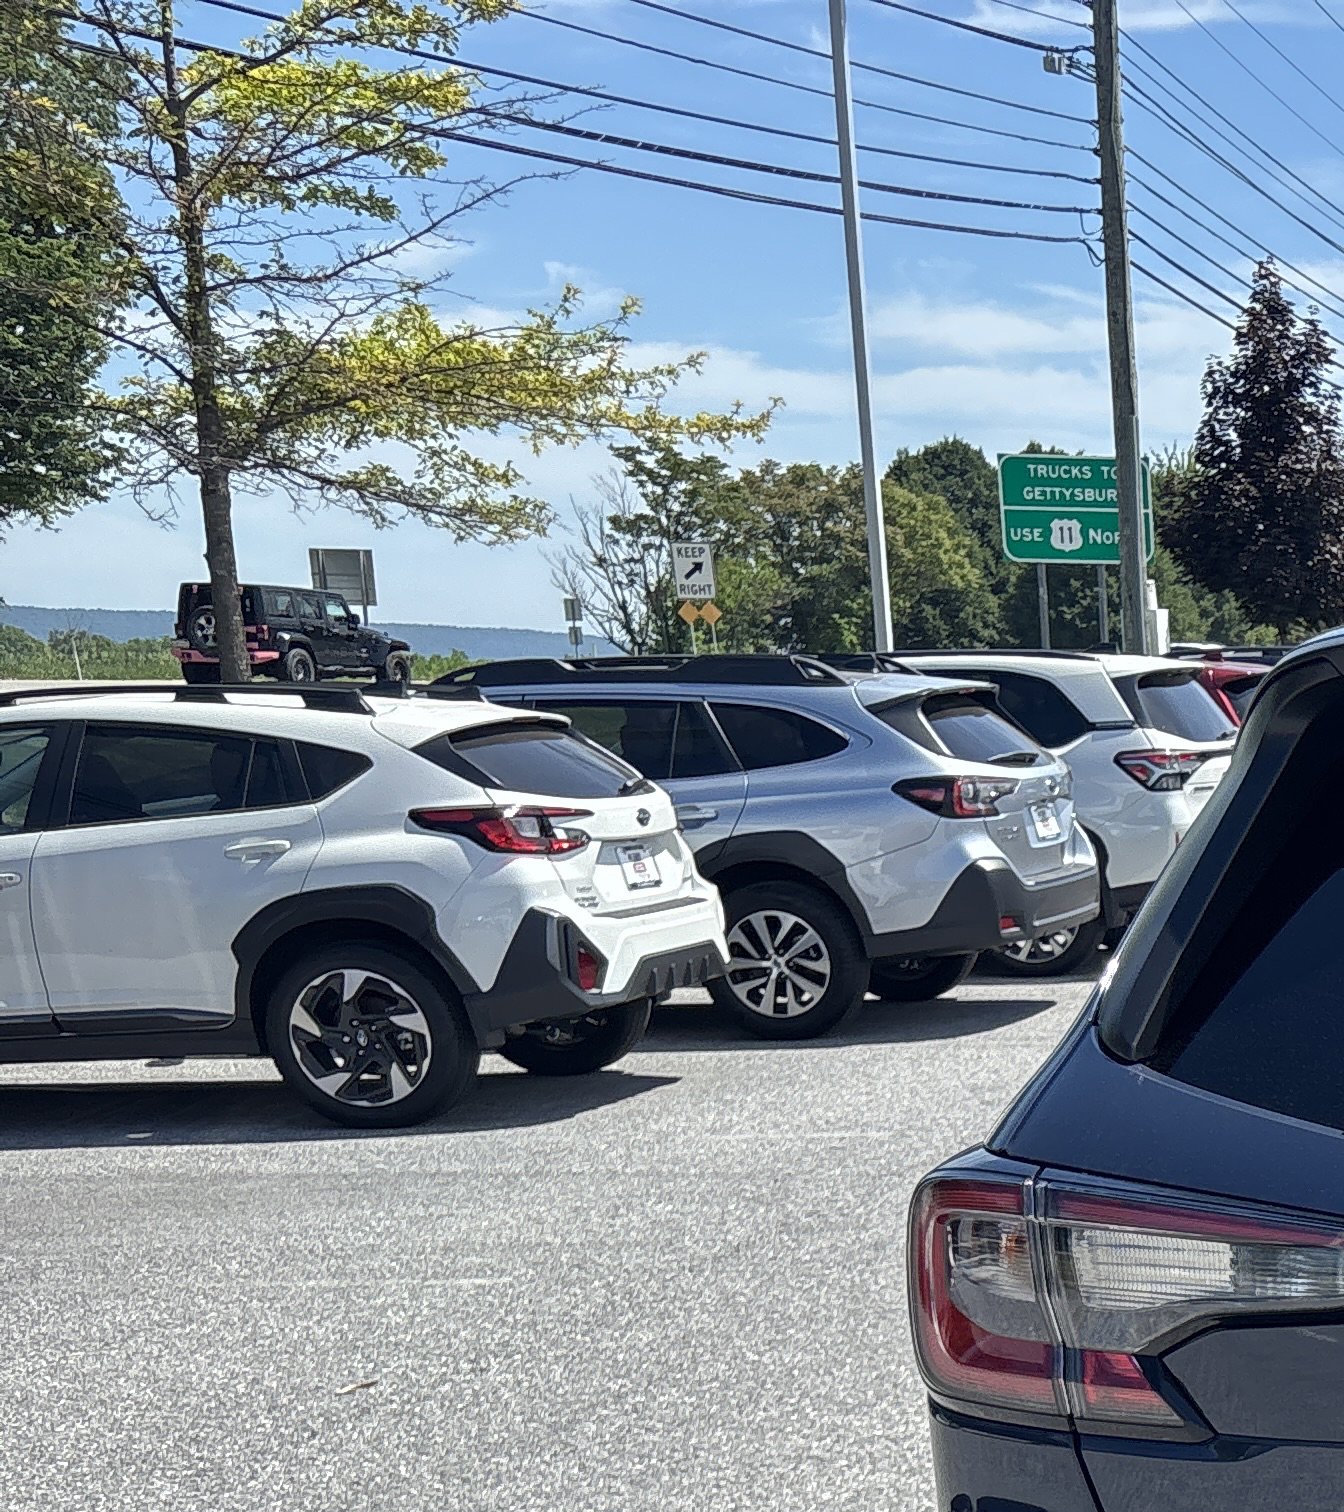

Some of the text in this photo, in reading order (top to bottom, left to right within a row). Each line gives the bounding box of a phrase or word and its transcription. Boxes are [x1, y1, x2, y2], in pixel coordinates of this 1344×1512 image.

[1027, 464, 1092, 480] TRUCKS
[1023, 487, 1118, 502] GETTYSBUR
[1010, 527, 1044, 542] USE
[1058, 526, 1073, 544] 11
[676, 546, 706, 558] KEEP
[679, 583, 712, 595] RIGHT
